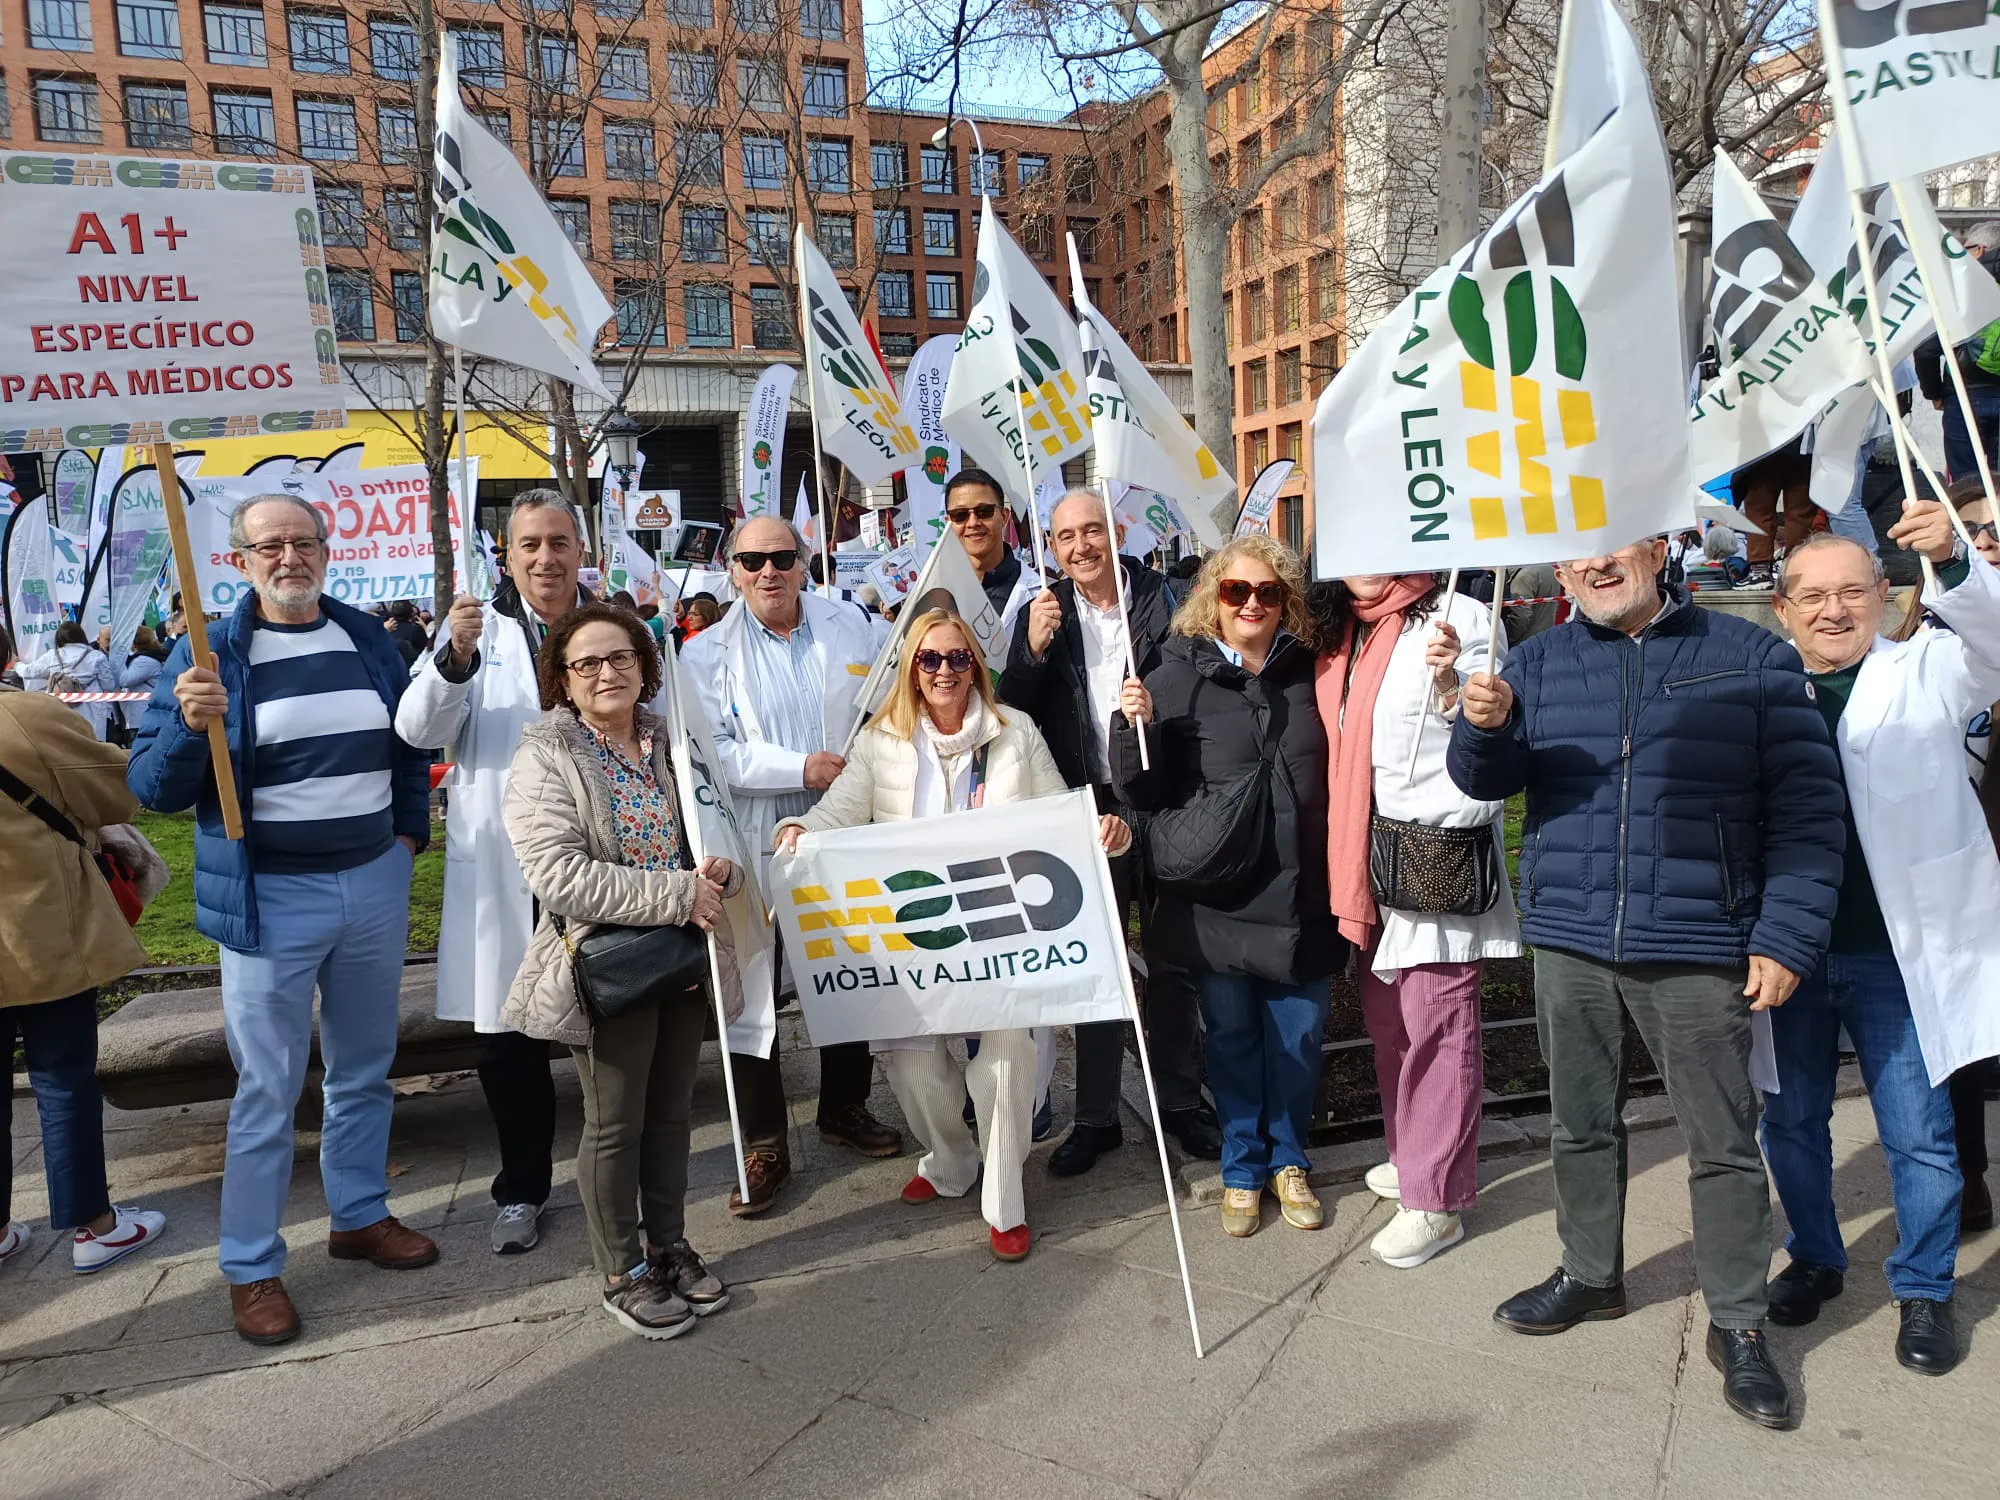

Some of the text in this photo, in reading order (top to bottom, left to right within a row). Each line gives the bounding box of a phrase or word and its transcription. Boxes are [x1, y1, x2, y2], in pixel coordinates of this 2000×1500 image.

[66, 211, 188, 255] A1+
[77, 275, 199, 303] NIVEL
[30, 315, 255, 353] ESPECÍFICO
[0, 362, 294, 403] PARA MÉDICOS
[929, 367, 940, 384] de
[754, 386, 769, 437] Sindicato
[763, 384, 777, 439] Médico de
[919, 373, 932, 441] Sindicato
[1392, 290, 1455, 543] LA y LEÓN
[845, 409, 896, 460] LEÓN
